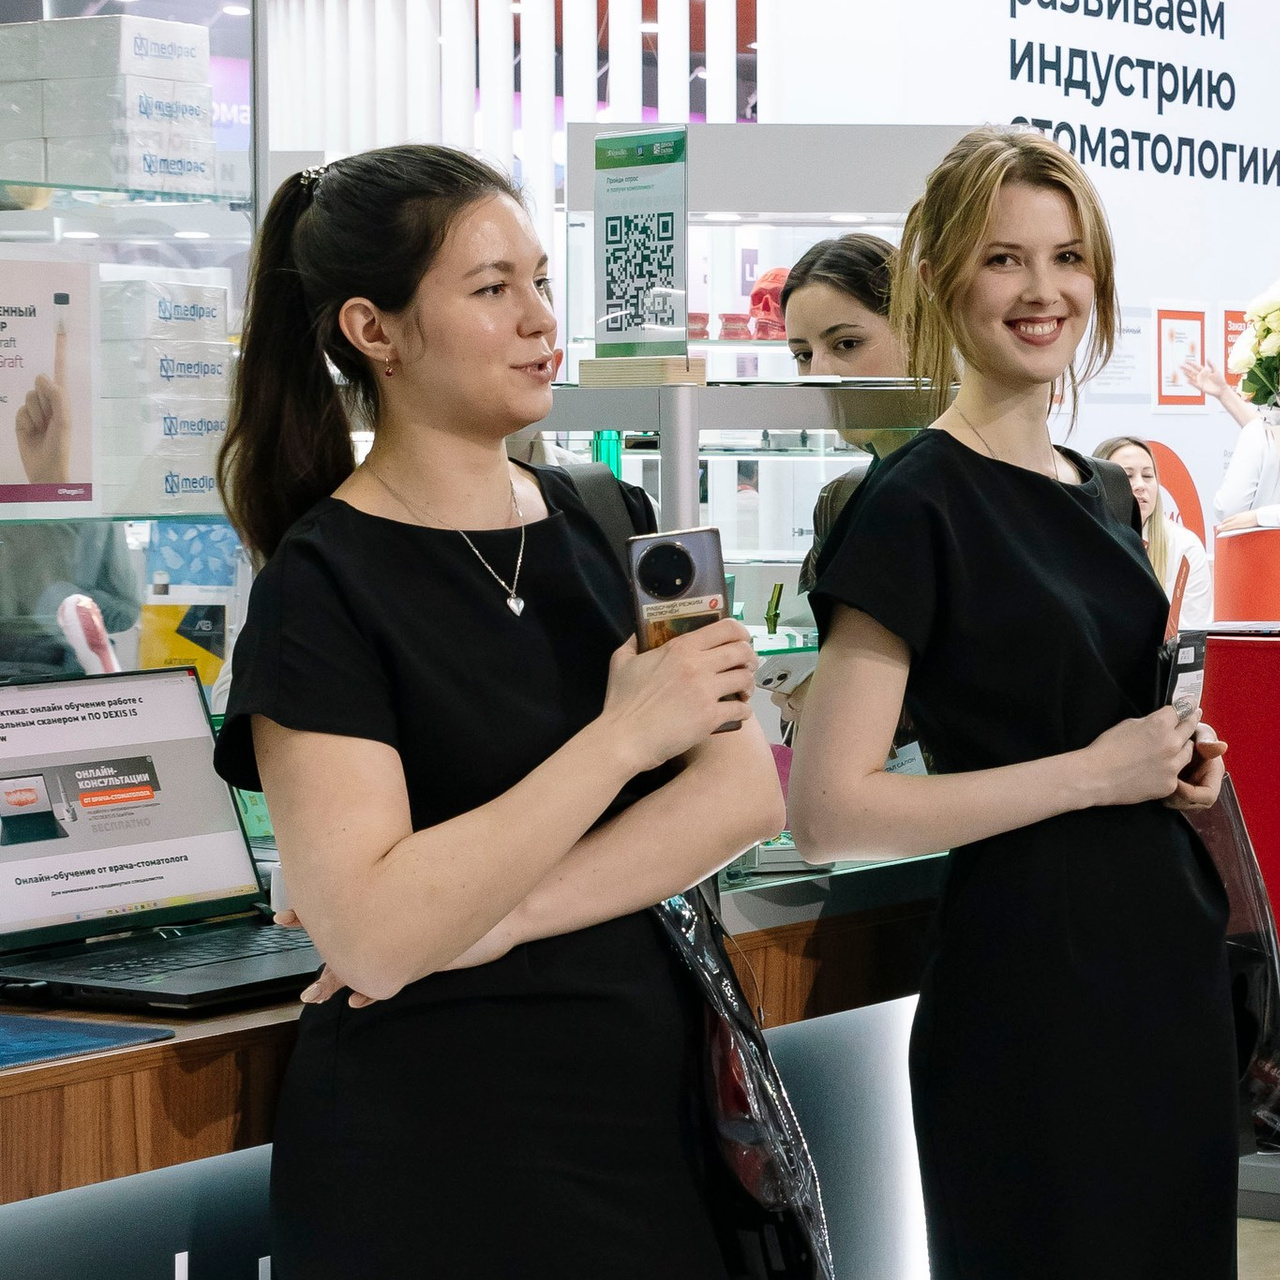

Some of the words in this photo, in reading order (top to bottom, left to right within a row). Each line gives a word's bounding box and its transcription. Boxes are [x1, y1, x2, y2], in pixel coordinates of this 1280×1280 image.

[1009, 38, 1237, 115] индустрию
[175, 360, 223, 376] medipac
[30, 701, 63, 714] онлайн
[64, 699, 106, 713] обучение
[107, 696, 137, 708] работе
[102, 709, 129, 720] DEXIS
[14, 867, 97, 887] Онлайн-обучение
[108, 853, 189, 873] врача-стоматолога
